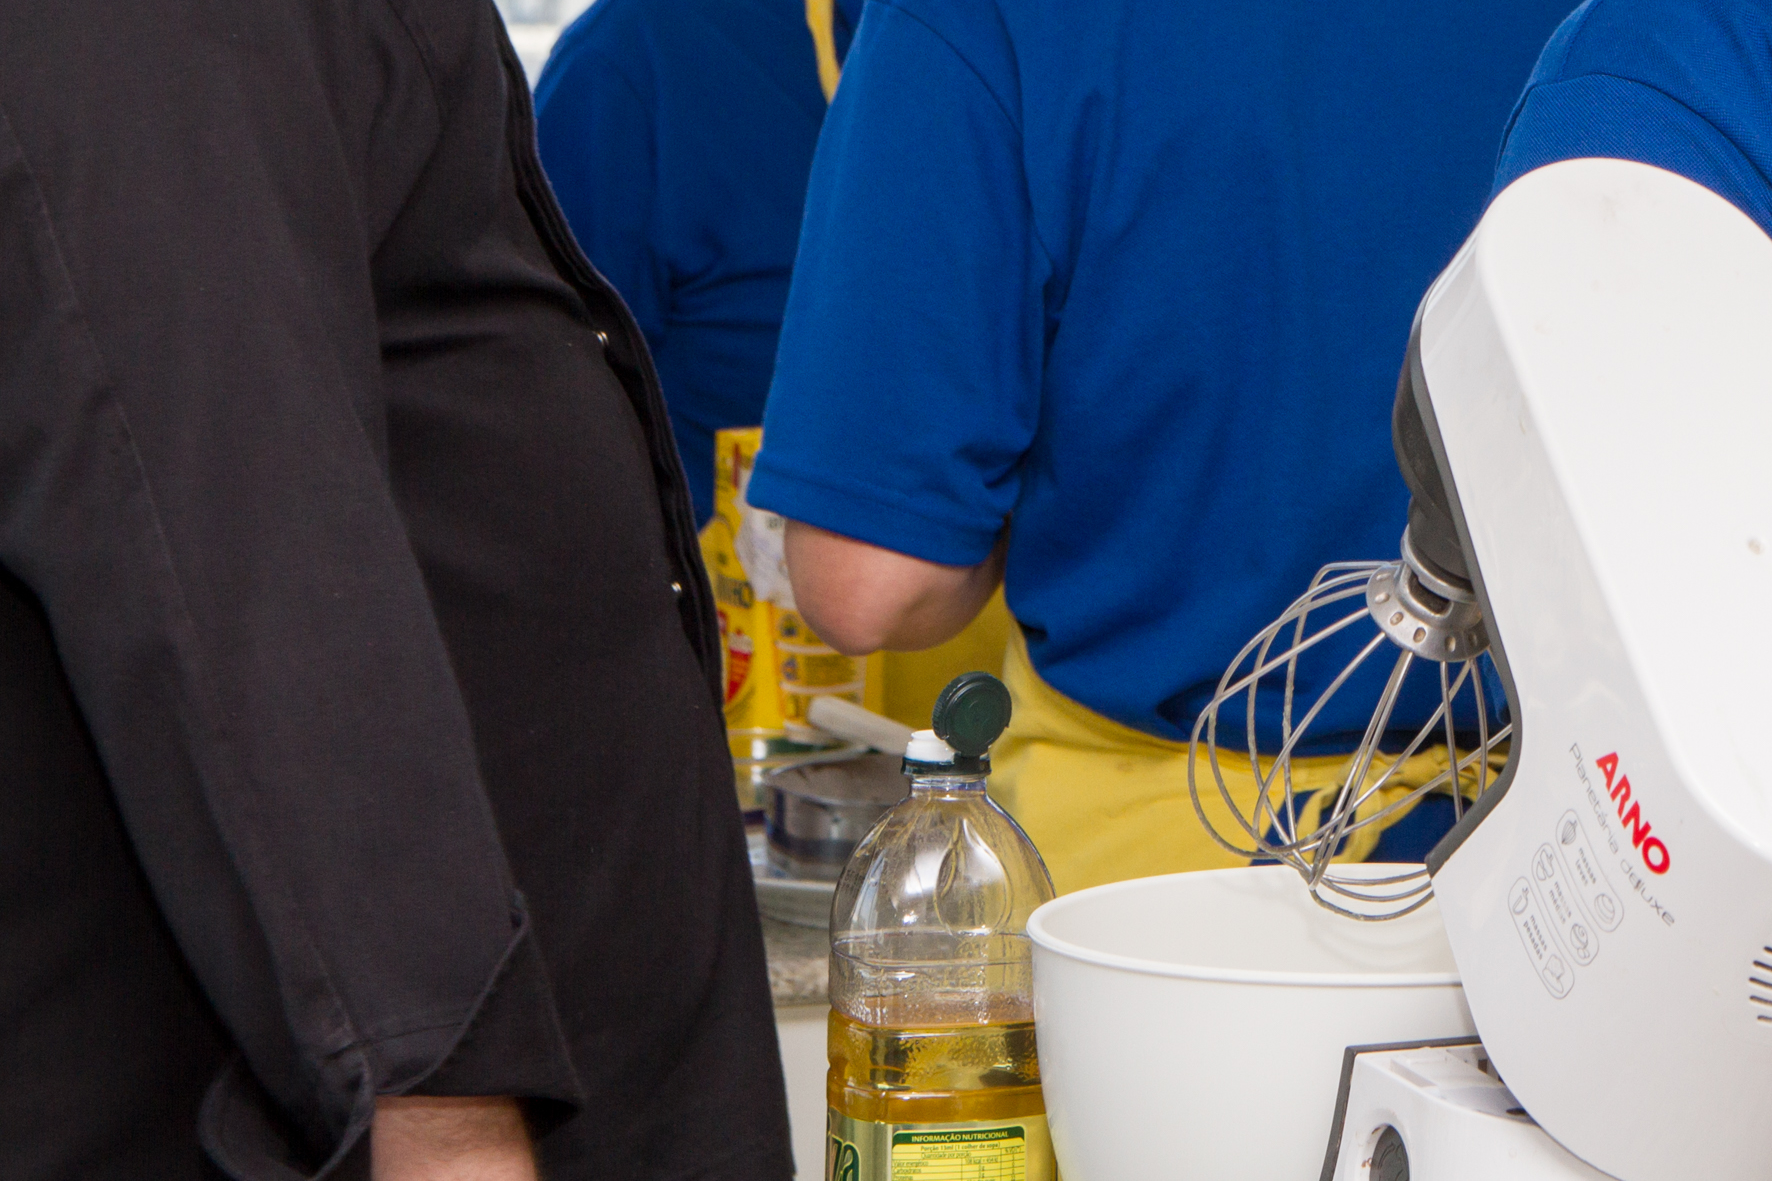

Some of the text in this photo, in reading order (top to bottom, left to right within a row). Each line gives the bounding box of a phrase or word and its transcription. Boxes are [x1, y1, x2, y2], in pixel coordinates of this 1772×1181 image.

[1596, 751, 1671, 875] ARNO
[1569, 742, 1676, 927] Planetária deluxe
[1575, 859, 1589, 886] leves
[1579, 847, 1597, 884] massas
[1523, 920, 1543, 960] pesadas
[1530, 914, 1548, 951] massas
[911, 1131, 1009, 1143] INFORMAÇÃO NUTRICIONAL
[961, 1142, 978, 1150] colher
